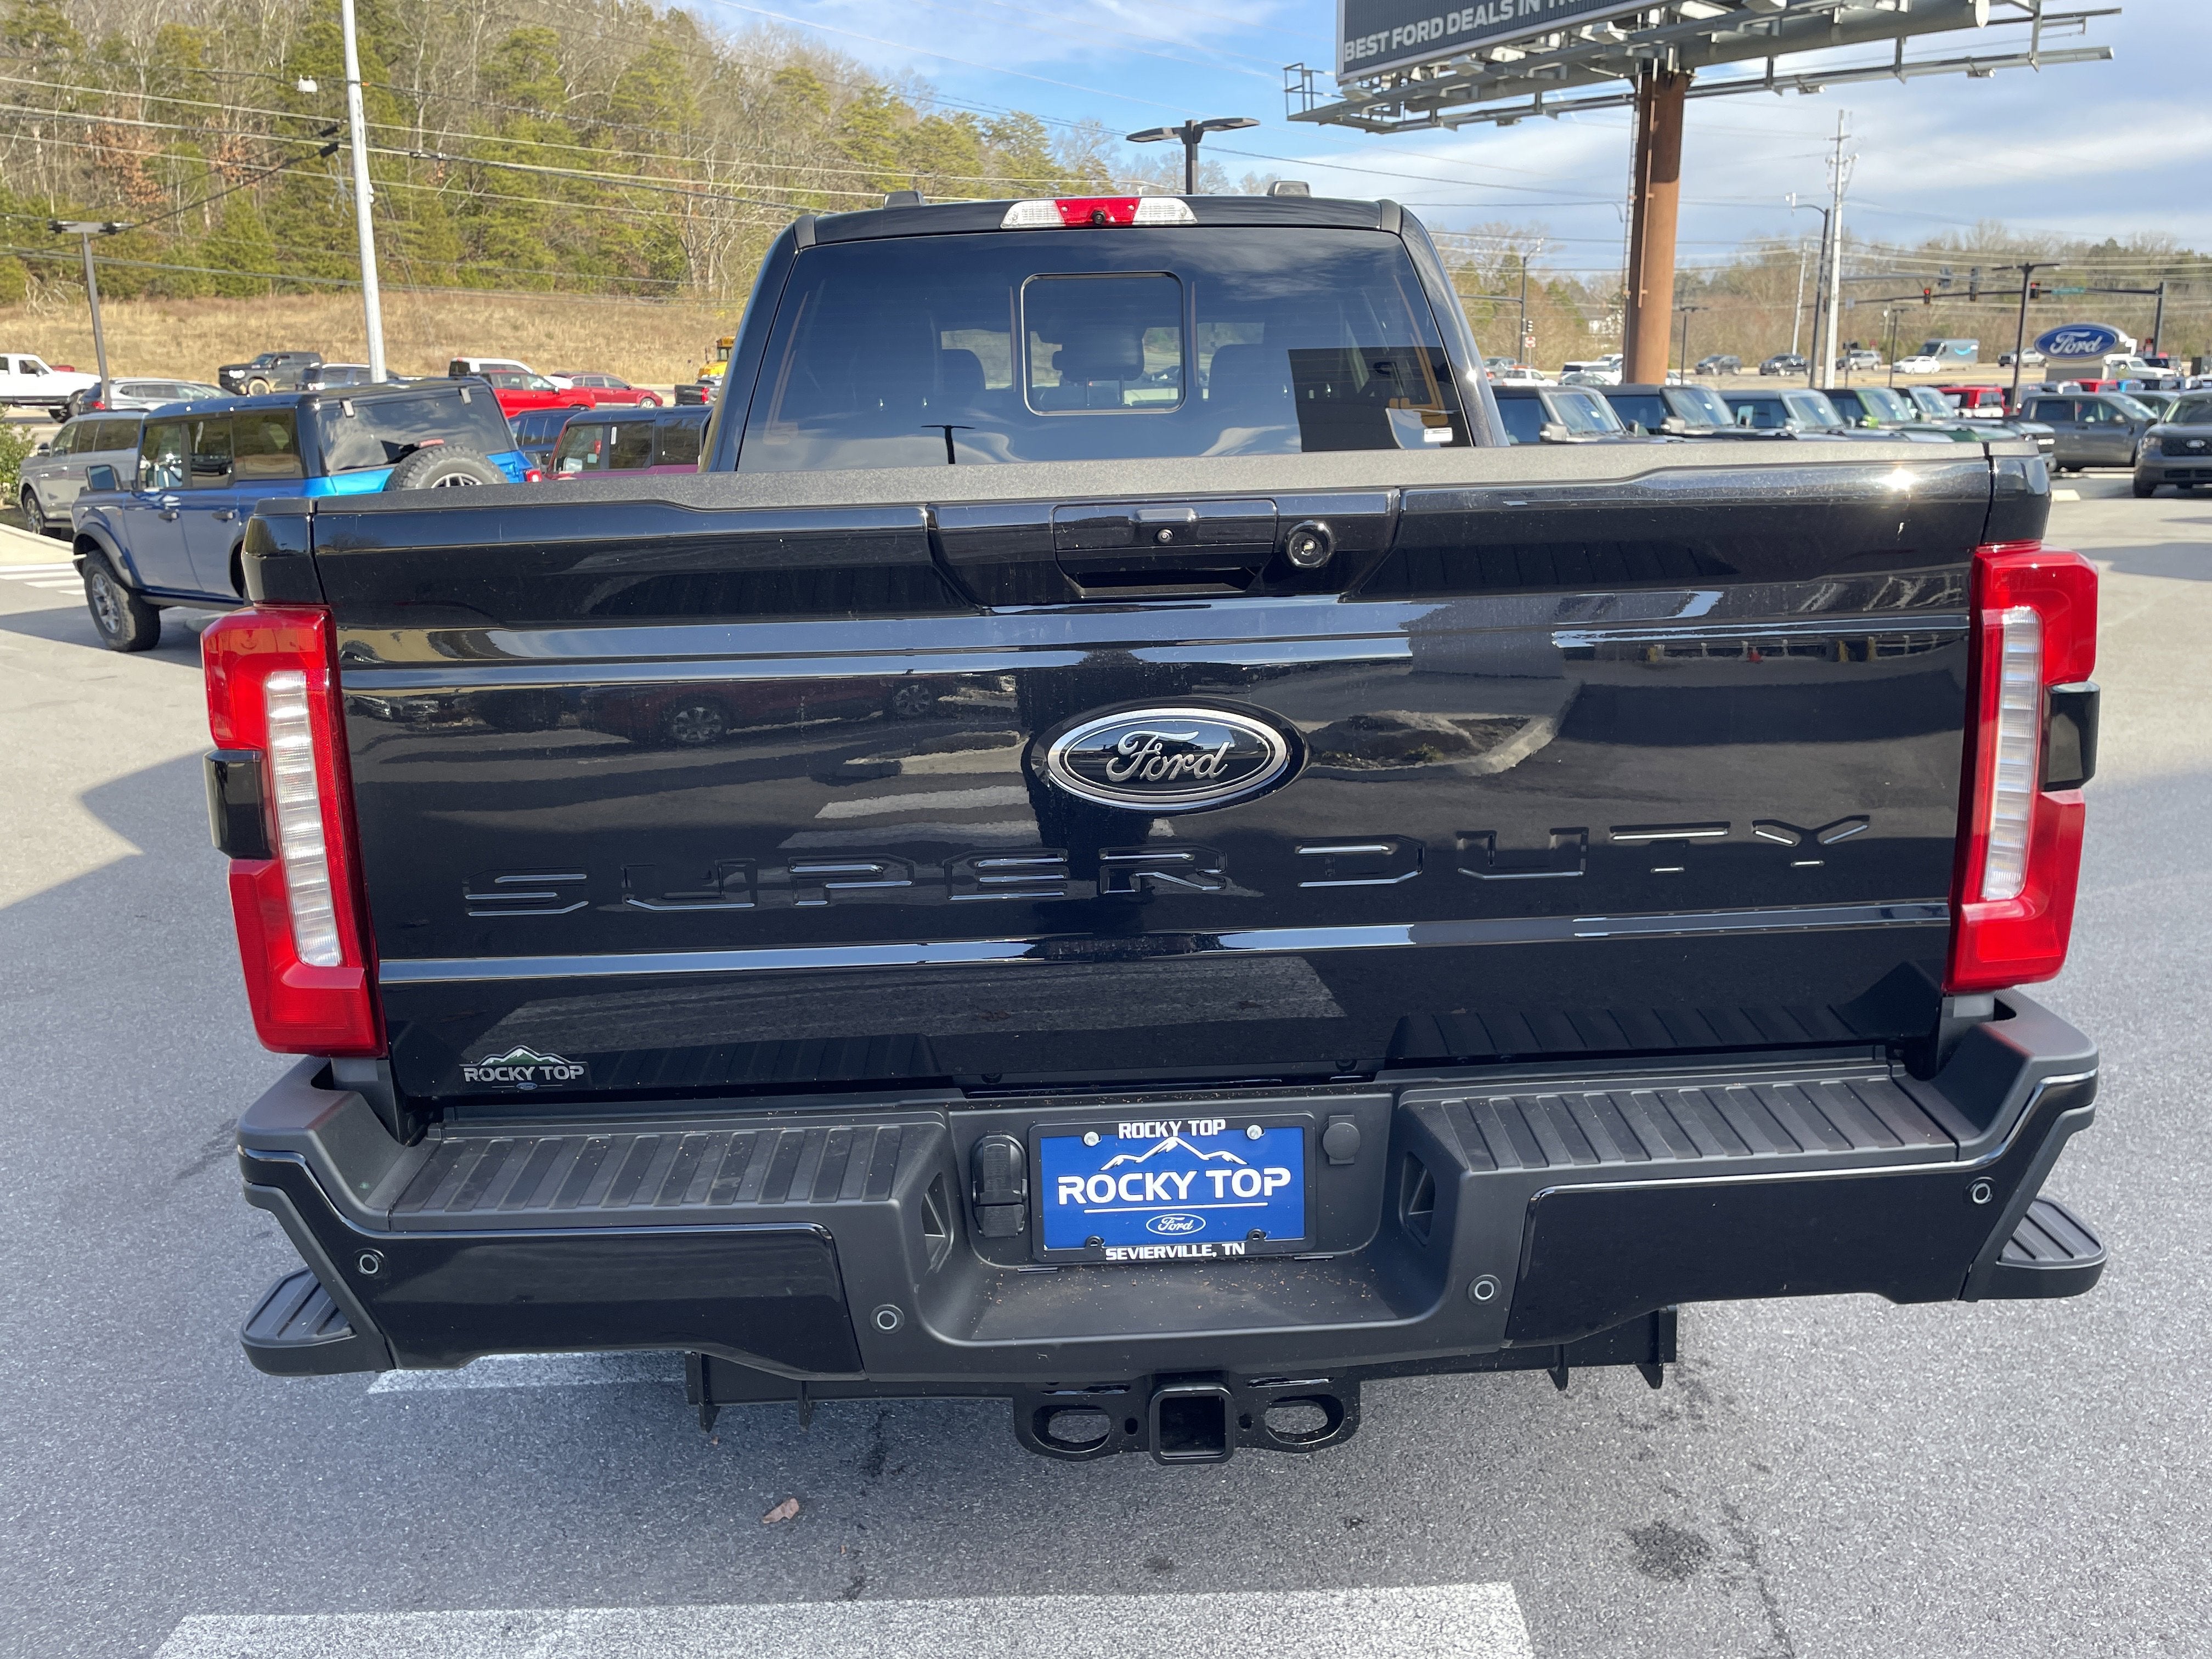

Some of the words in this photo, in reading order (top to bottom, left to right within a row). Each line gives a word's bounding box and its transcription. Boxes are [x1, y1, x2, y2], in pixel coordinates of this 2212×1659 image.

[1345, 31, 1390, 63] BEST
[1391, 16, 1444, 50] FORD
[1446, 0, 1514, 35] DEALS
[1517, 0, 1541, 16] IN
[2050, 331, 2103, 354] Ford
[1105, 730, 1231, 783] Ford
[462, 842, 1228, 916] SUPER
[1295, 814, 1870, 888] DUTY
[464, 1066, 535, 1082] ROCKY
[539, 1065, 584, 1080] TOP
[1118, 1121, 1182, 1139] ROCKY
[1187, 1119, 1226, 1136] TOP
[1058, 1170, 1198, 1205] ROCKY
[1205, 1167, 1291, 1199] TOP
[1157, 1217, 1194, 1231] Ford
[1105, 1244, 1217, 1261] SEVIERVILLE,
[1221, 1242, 1245, 1256] TN
